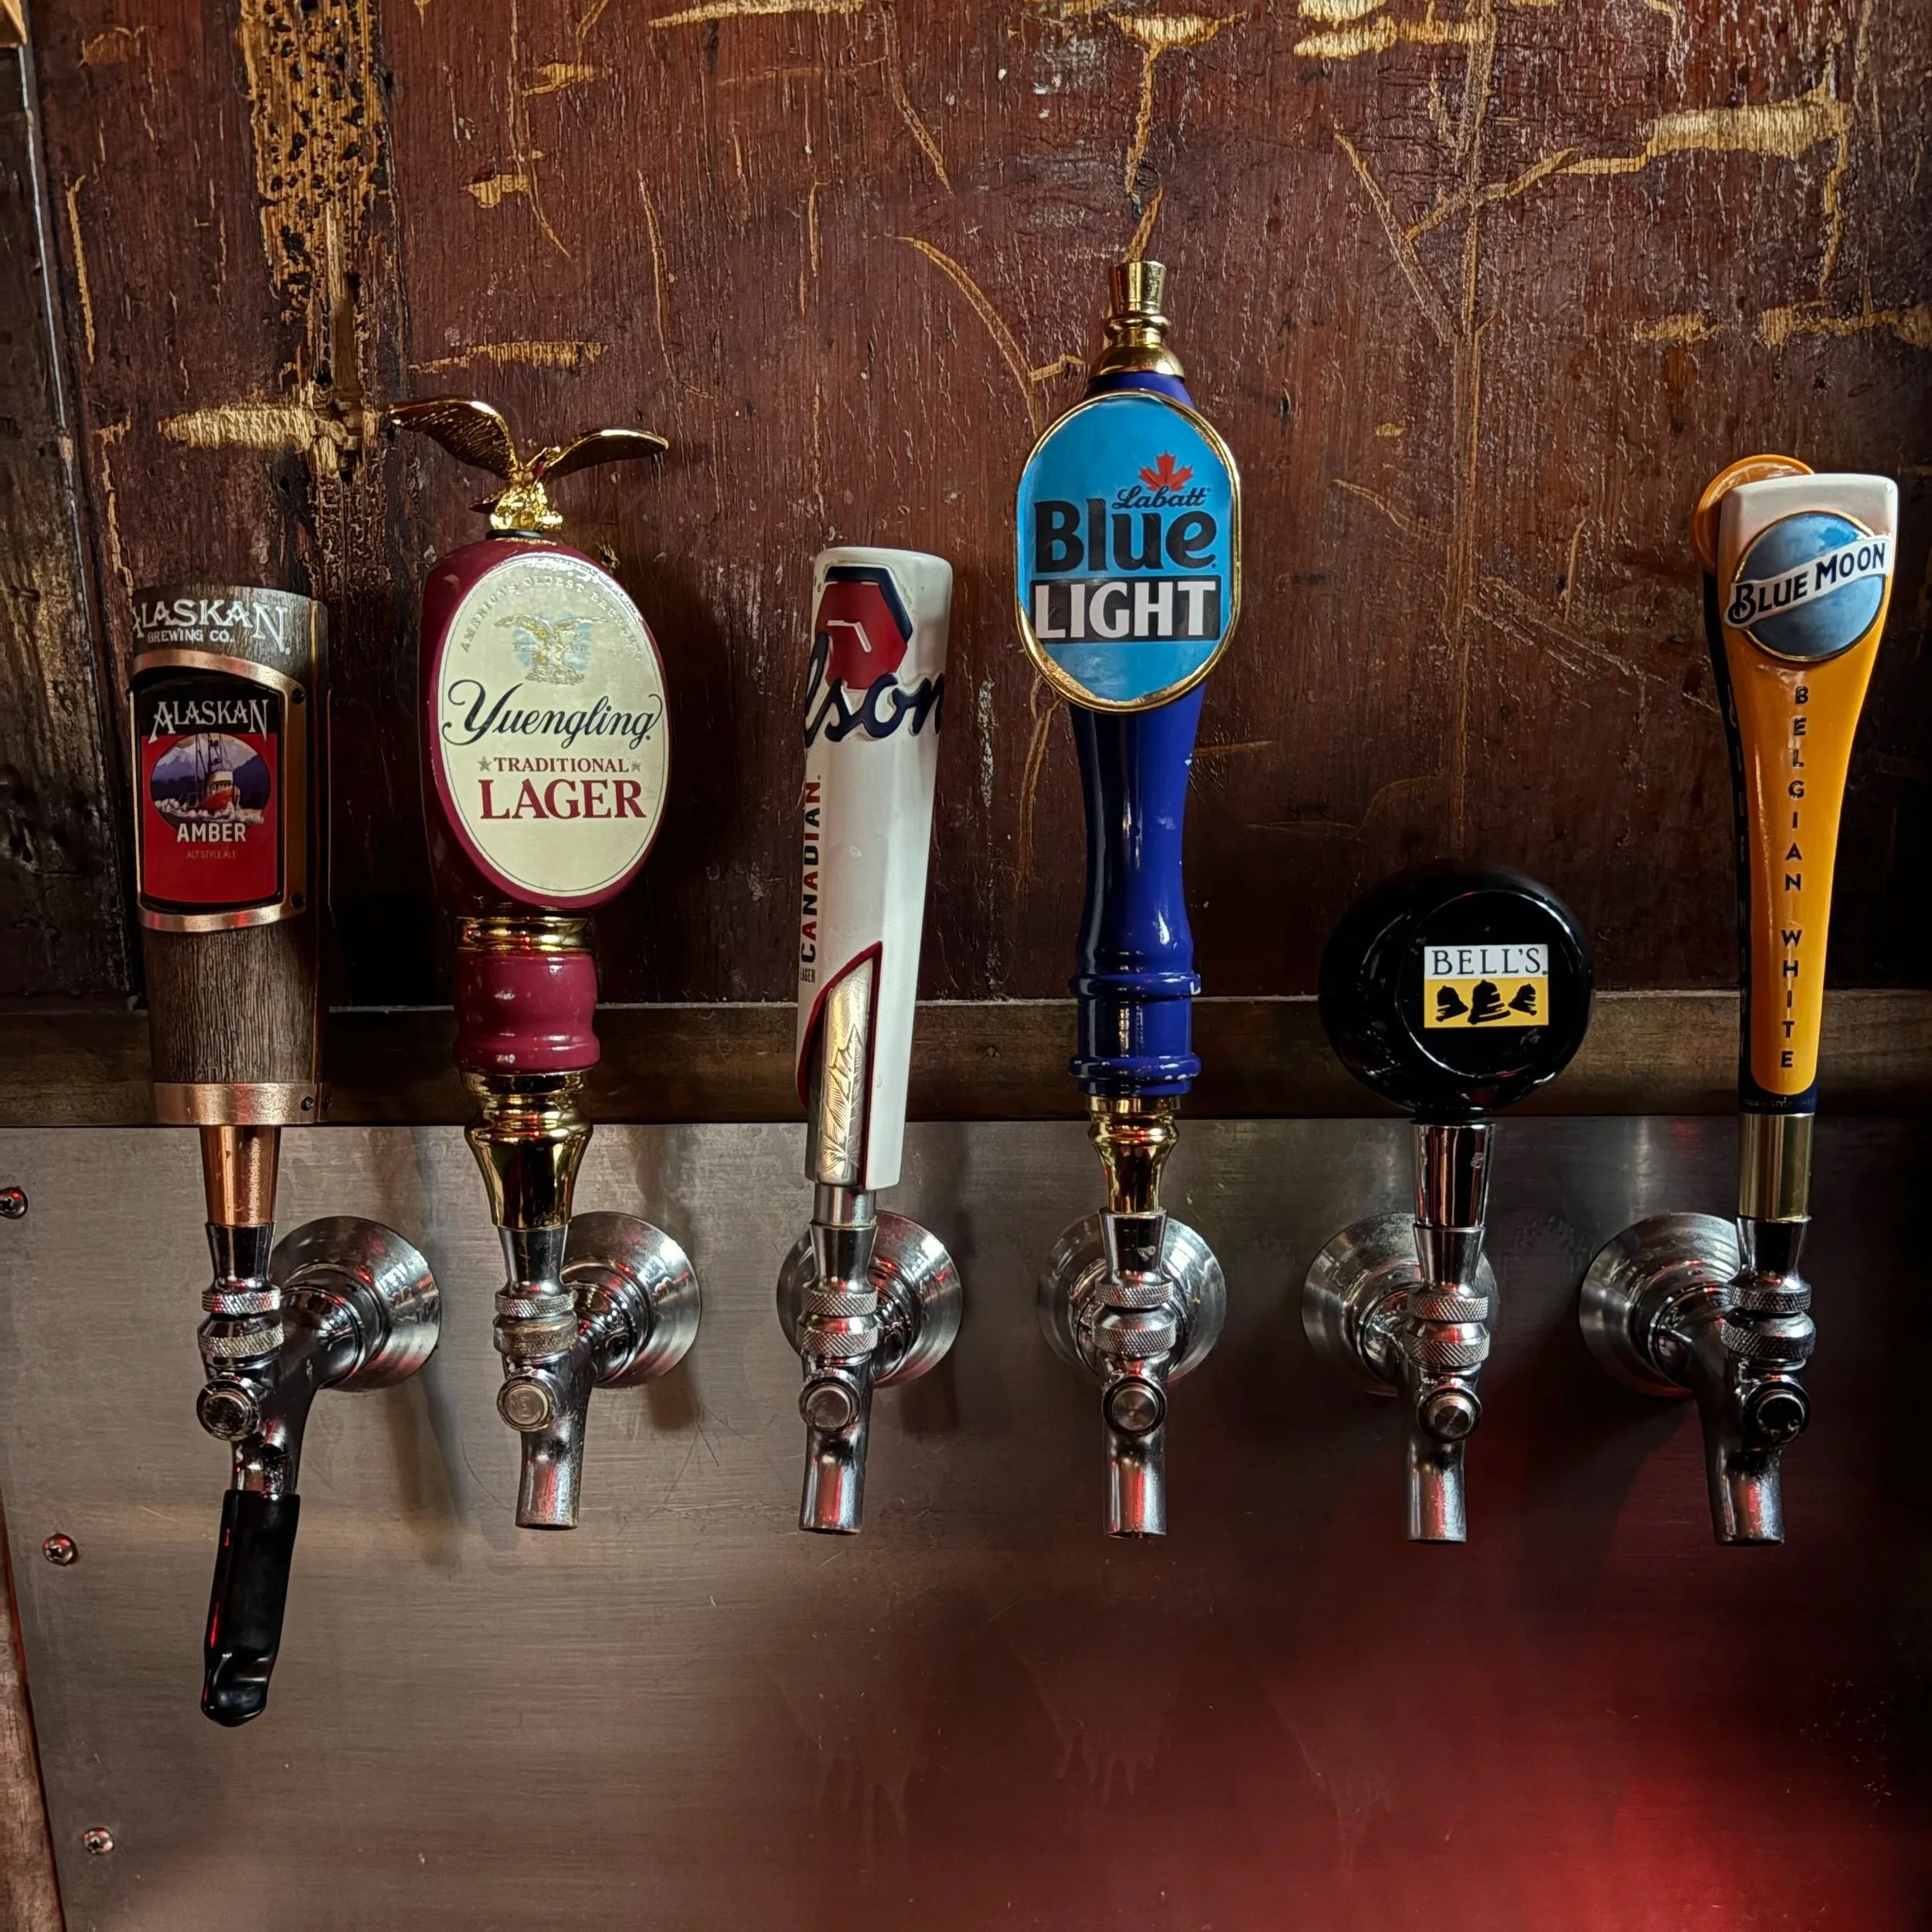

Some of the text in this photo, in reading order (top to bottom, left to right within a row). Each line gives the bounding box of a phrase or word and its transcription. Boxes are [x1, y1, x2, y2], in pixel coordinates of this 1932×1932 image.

[1111, 485, 1209, 510] Labatt
[1033, 498, 1217, 573] Blue
[523, 576, 585, 593] OLDEST
[1728, 543, 1886, 624] BLUE MOON
[1034, 580, 1216, 639] LIGHT
[148, 628, 234, 644] BREWING CO.
[148, 699, 269, 743] ALASKAN
[442, 679, 663, 750] Yuengling
[493, 756, 630, 773] TRADITIONAL
[478, 777, 647, 819] LAGER
[176, 823, 247, 842] AMBER
[223, 850, 236, 859] ALE
[801, 782, 821, 963] CANADIAN
[1781, 685, 1809, 1068] BELGIAN WHITE
[1432, 947, 1541, 975] BELL'S
